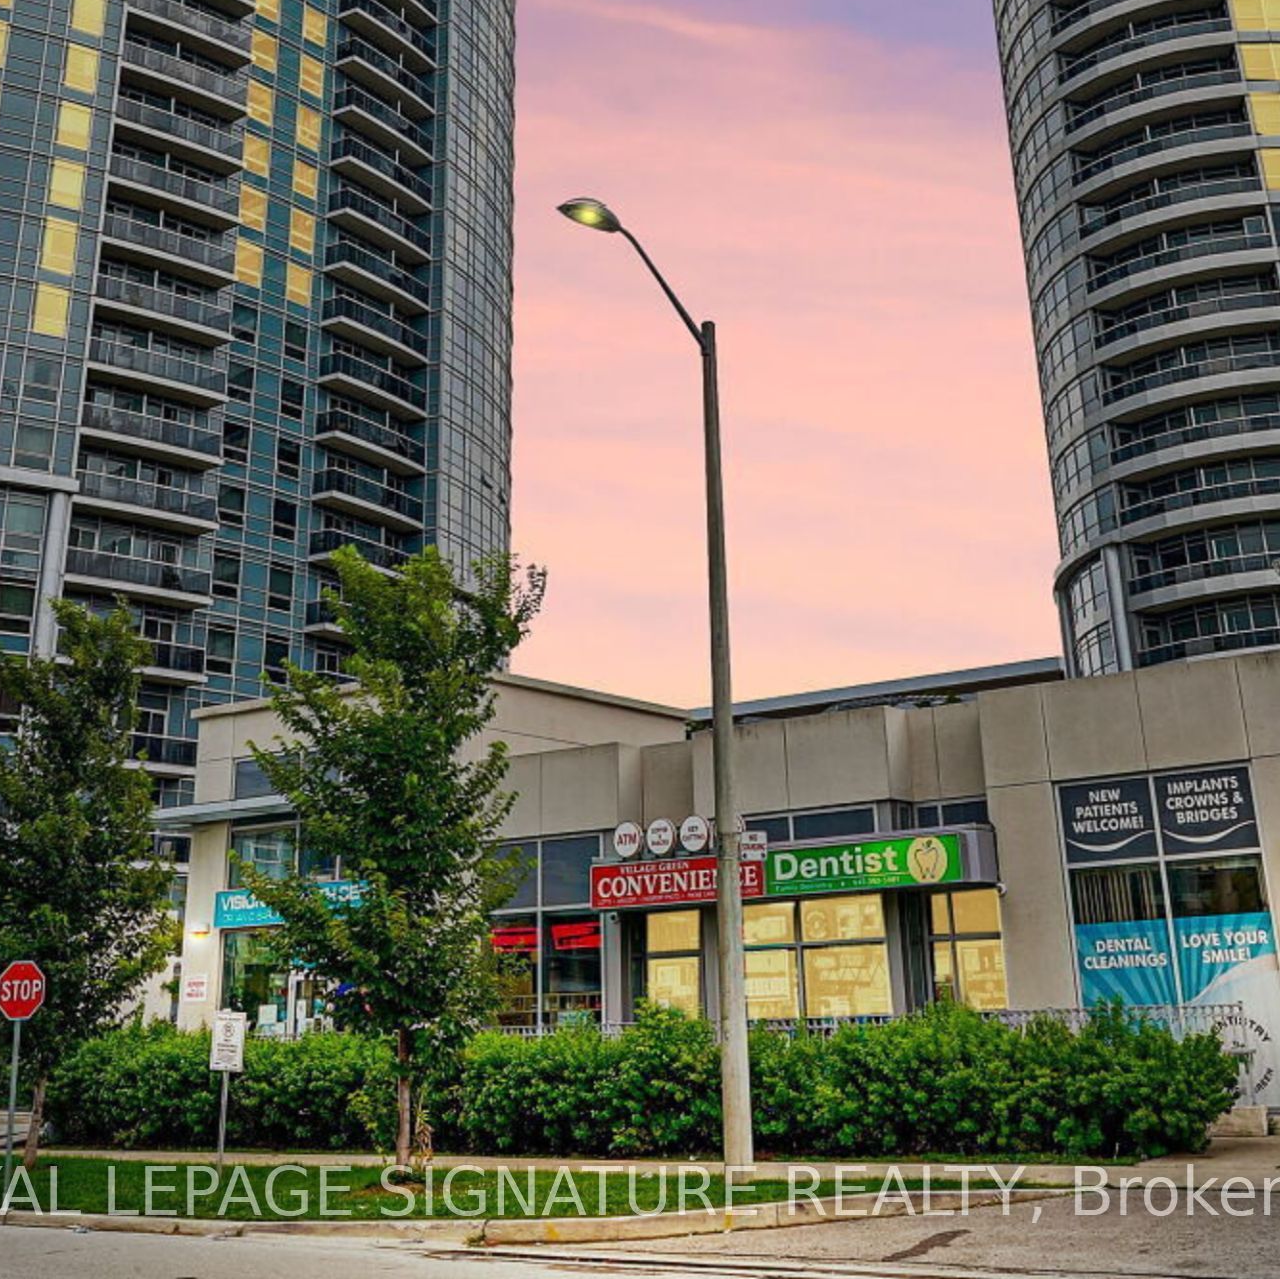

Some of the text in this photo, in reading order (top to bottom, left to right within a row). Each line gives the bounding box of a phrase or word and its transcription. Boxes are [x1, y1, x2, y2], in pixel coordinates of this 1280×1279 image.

[1167, 776, 1239, 795] IMPLANTS
[1088, 788, 1120, 803] NEW
[1166, 792, 1244, 810] CROWNS &
[1075, 801, 1138, 819] PATIENTS
[1176, 807, 1239, 824] BRIDGES
[1072, 816, 1144, 833] WELCOME!
[616, 832, 637, 846] ATM
[620, 861, 690, 875] VILLAGE GREEN
[774, 846, 899, 880] Dentist
[597, 865, 758, 898] CONVENIEE
[1095, 937, 1152, 953] DENTAL
[1182, 929, 1269, 949] LOVE YOUR
[1084, 952, 1168, 970] CLEANINGS
[1201, 947, 1252, 964] SMILE!
[1, 979, 42, 1002] STOP
